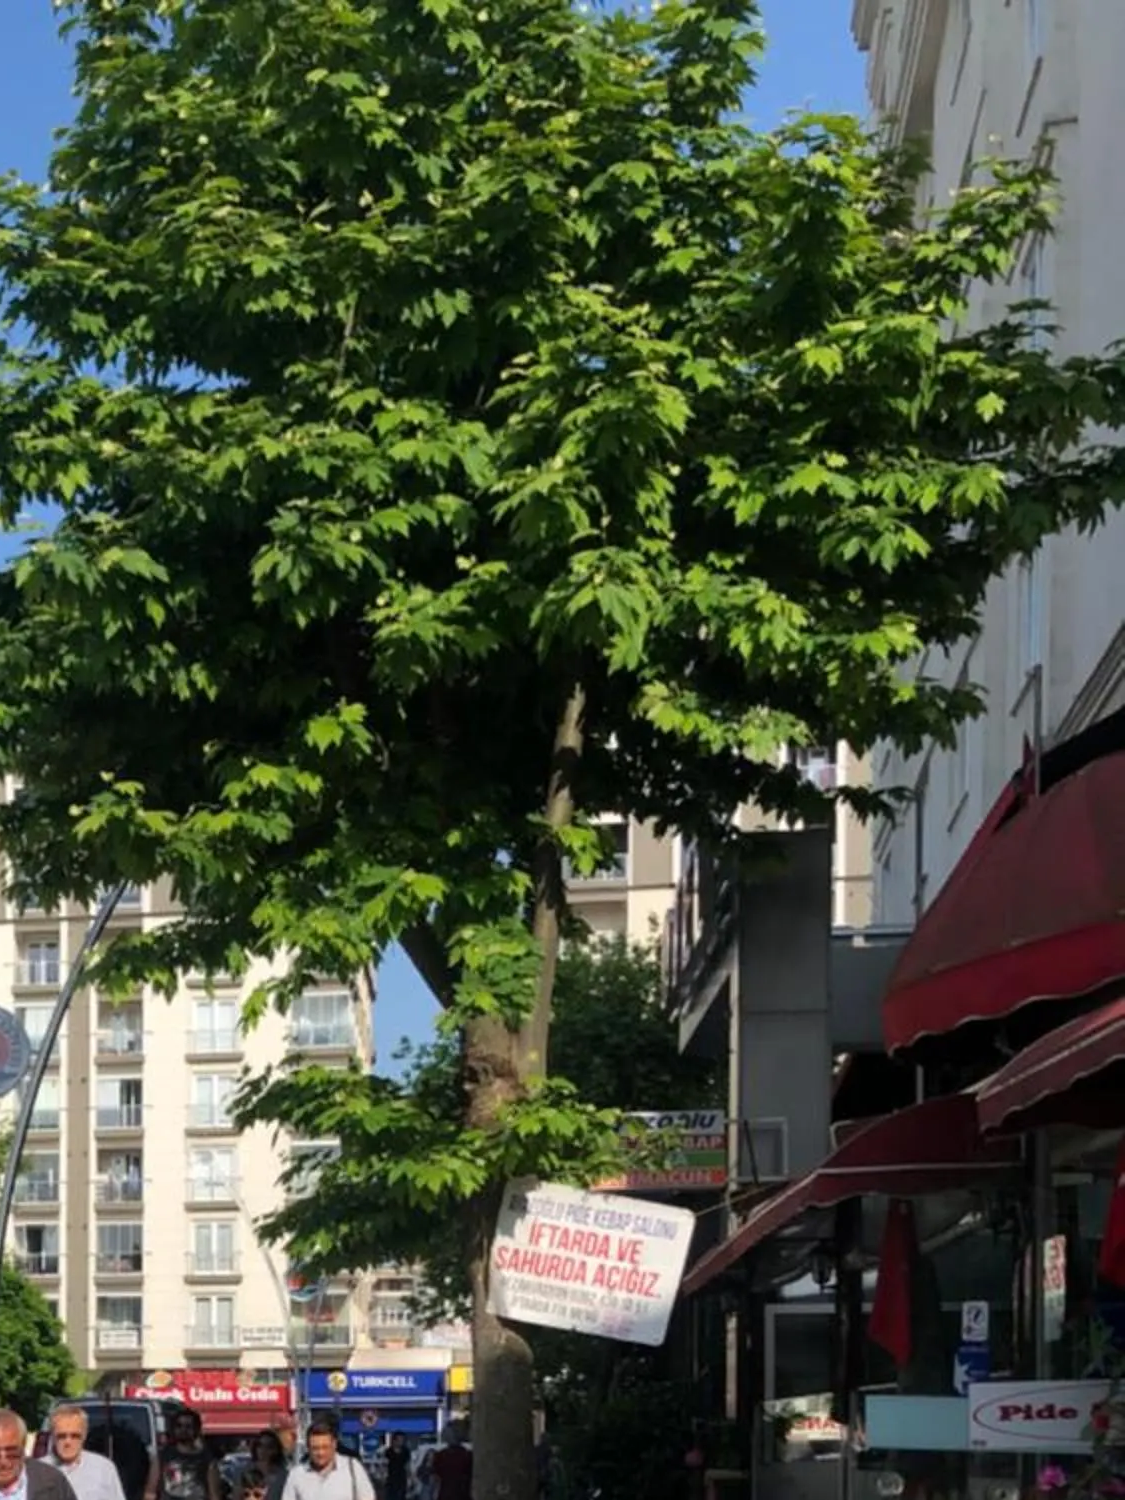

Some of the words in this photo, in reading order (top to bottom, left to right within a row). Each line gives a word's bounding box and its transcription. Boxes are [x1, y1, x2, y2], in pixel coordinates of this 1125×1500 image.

[529, 1217, 610, 1261] İFTARDA
[616, 1236, 644, 1264] VE
[495, 1246, 587, 1285] SAHURDA
[351, 1374, 418, 1388] TURKCELL
[998, 1403, 1079, 1422] Pide
